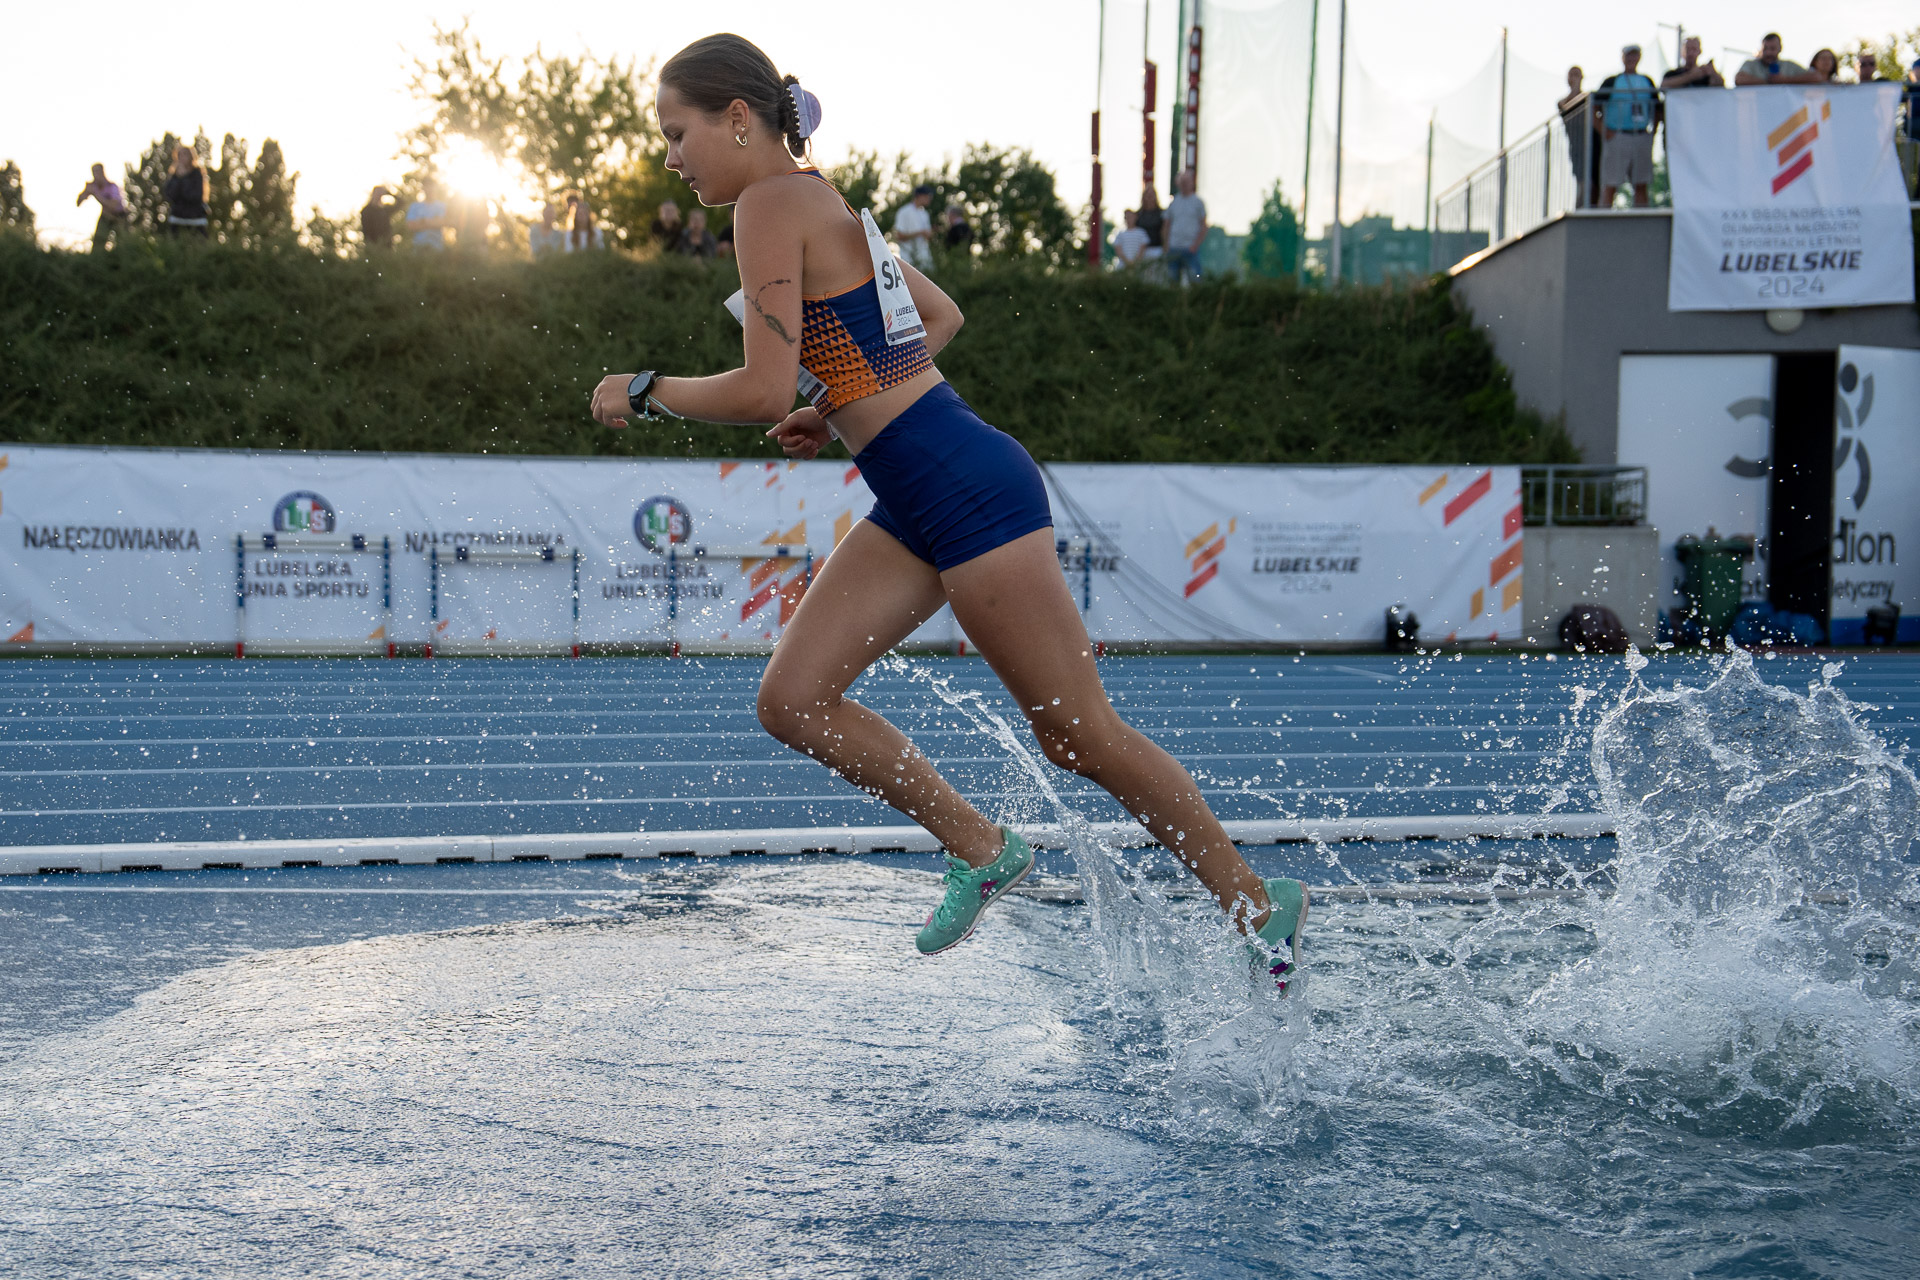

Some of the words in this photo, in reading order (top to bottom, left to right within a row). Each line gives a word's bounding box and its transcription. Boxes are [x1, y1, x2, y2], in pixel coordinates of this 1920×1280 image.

[1720, 250, 1862, 273] LUBELSKIE
[1758, 276, 1824, 297] 2024
[23, 525, 200, 552] NAŁĘCZOWIANKA
[255, 561, 352, 577] LUBELSKA
[1252, 556, 1361, 573] LUBELSKIE
[293, 582, 369, 598] SPORTU
[602, 584, 646, 599] UNIA
[1281, 575, 1332, 593] 2024
